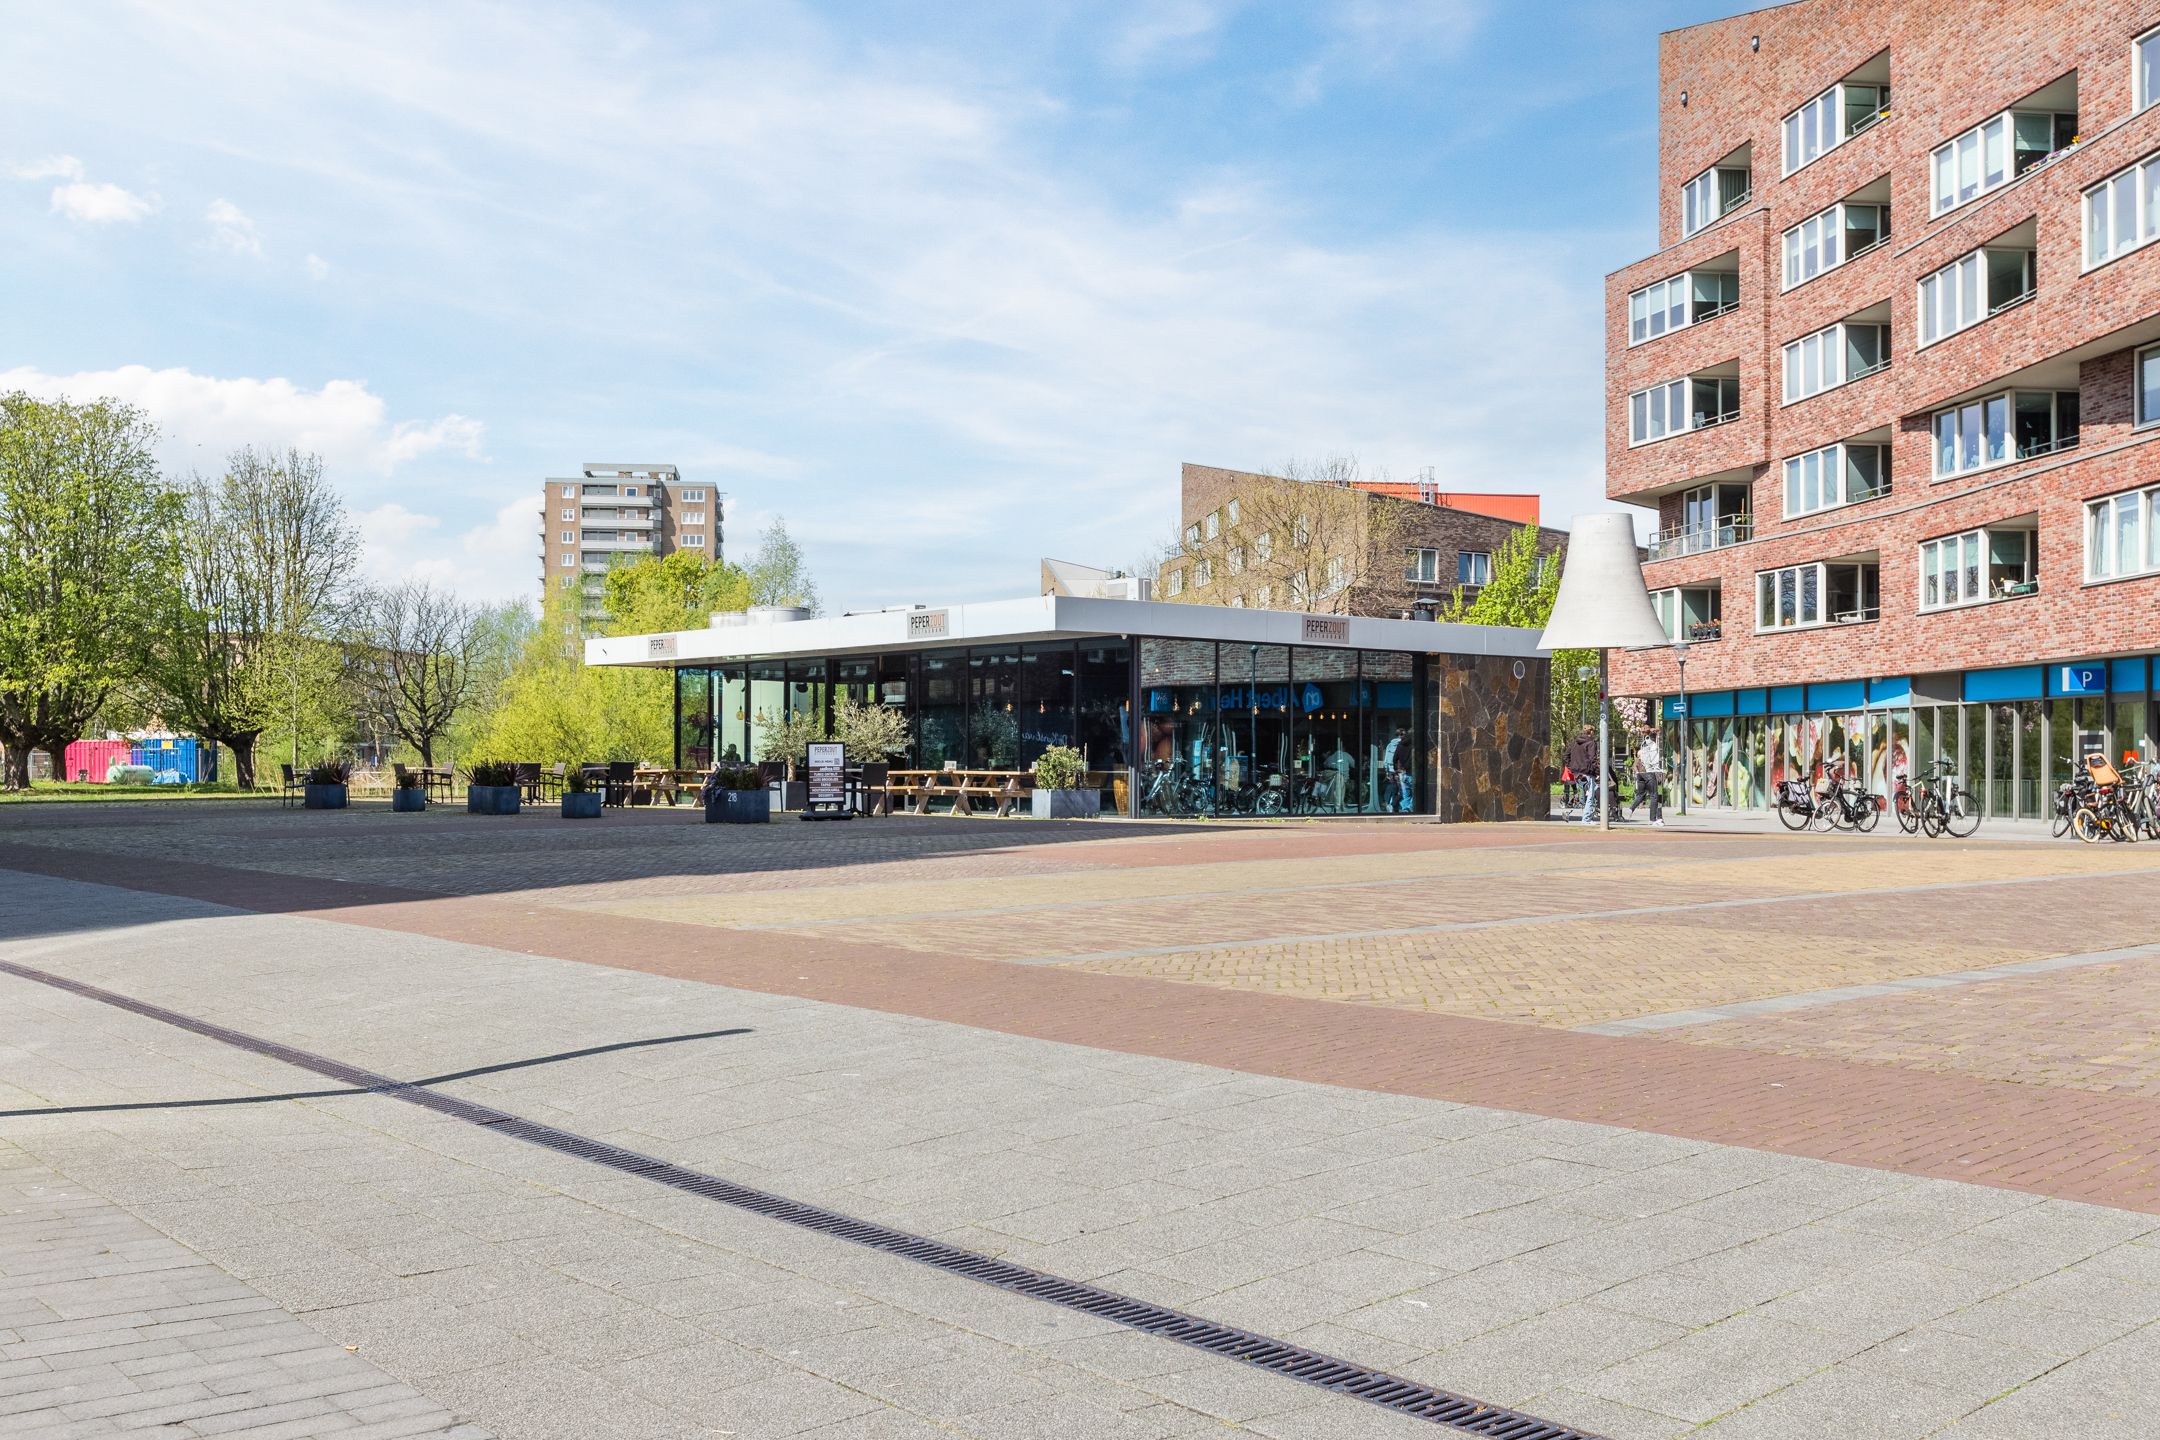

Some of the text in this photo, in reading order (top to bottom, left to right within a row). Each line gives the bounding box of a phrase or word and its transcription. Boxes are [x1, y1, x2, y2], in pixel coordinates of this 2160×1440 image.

[911, 614, 945, 629] PEPERZOUT
[1306, 619, 1346, 634] PEPERZOUT
[2082, 671, 2093, 688] P
